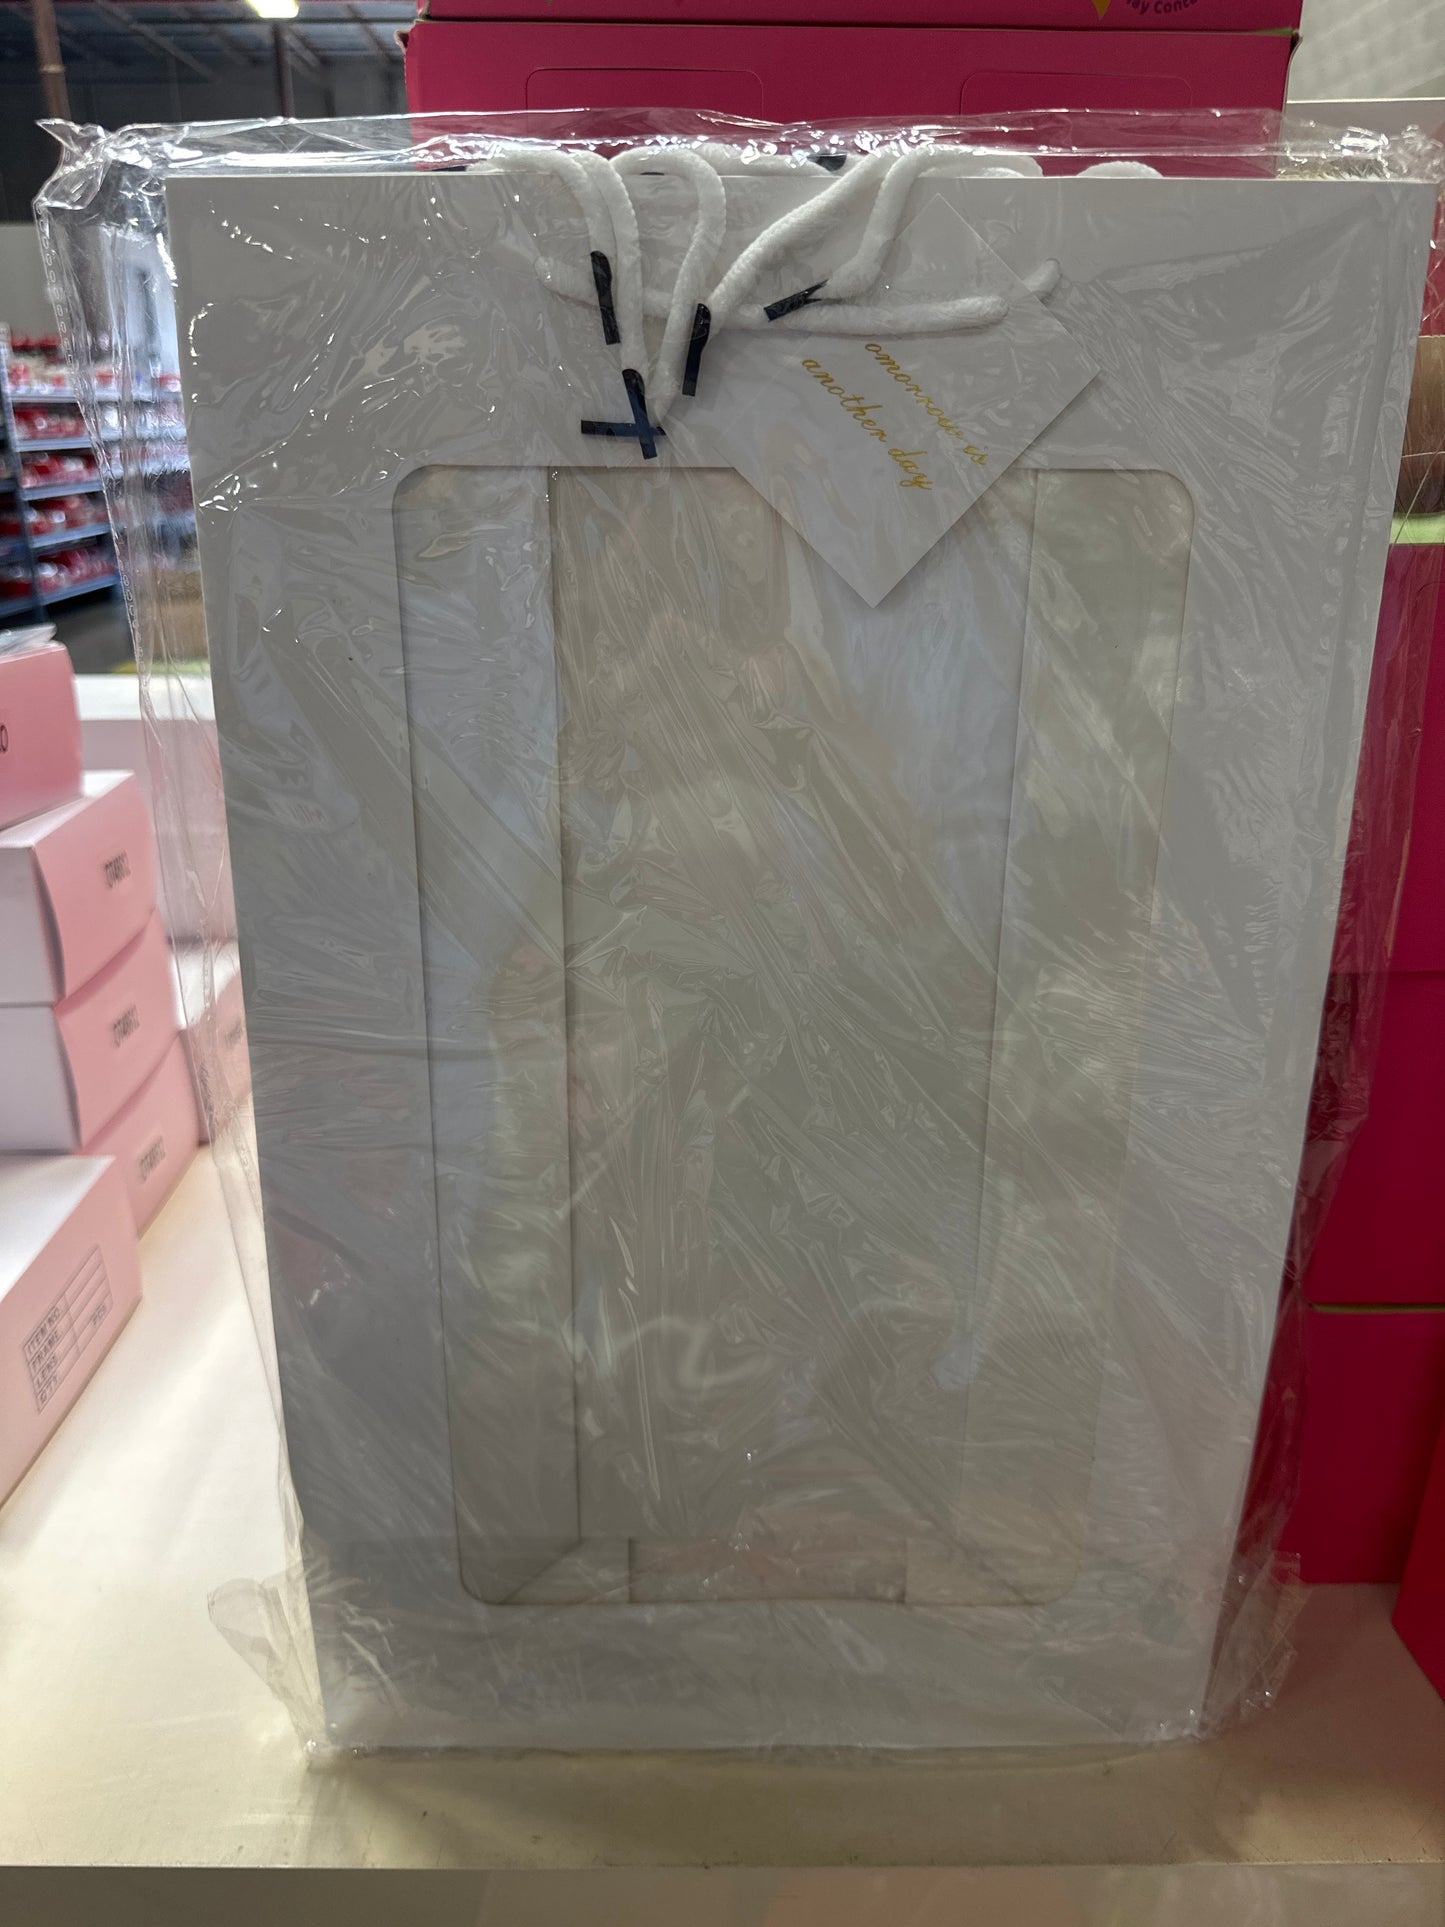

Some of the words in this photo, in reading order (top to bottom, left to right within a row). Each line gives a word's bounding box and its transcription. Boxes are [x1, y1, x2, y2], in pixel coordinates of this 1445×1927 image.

[801, 358, 889, 442] another
[887, 447, 933, 490] day
[863, 341, 964, 440] omorrow
